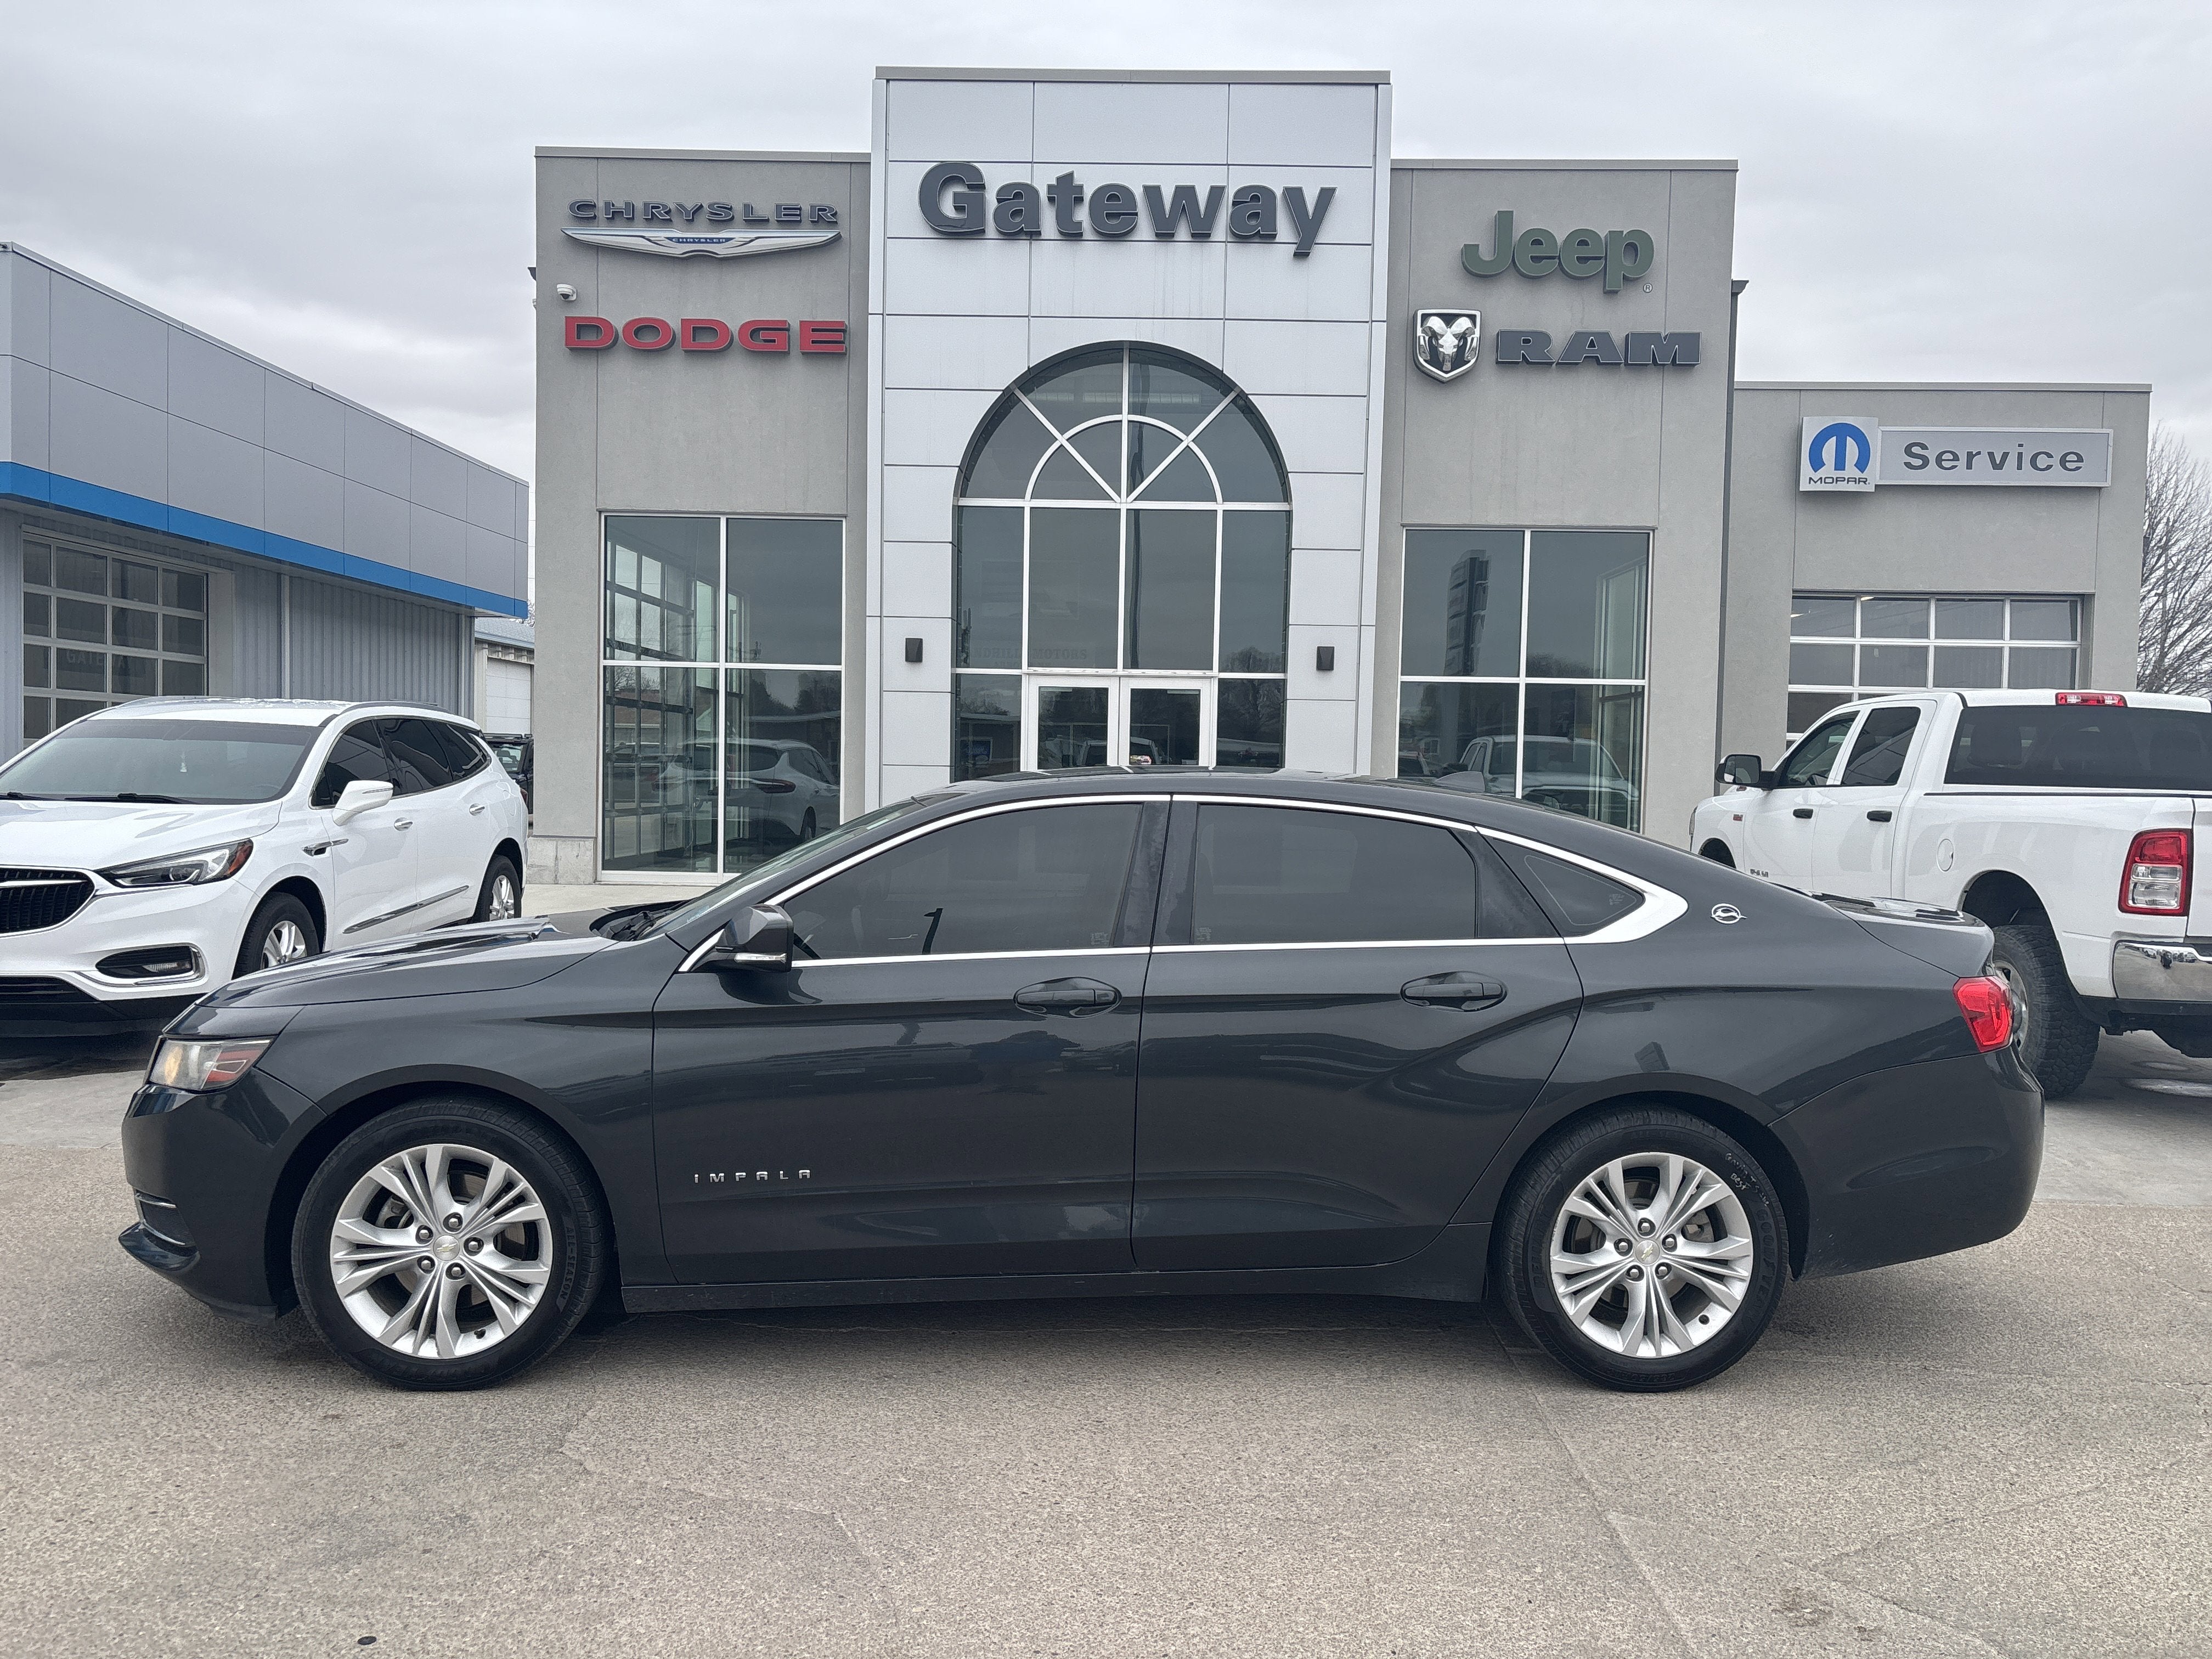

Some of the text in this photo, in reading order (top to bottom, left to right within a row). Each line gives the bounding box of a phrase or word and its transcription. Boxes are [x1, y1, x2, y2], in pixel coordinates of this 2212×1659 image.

[568, 199, 838, 223] CHRYSLER
[918, 161, 1338, 256] Gateway
[1461, 210, 1654, 293] Jeep
[565, 315, 847, 354] DODGE
[1496, 329, 1702, 366] RAM
[1903, 442, 2085, 472] Service
[1808, 476, 1868, 485] MOPAR
[695, 1170, 810, 1183] IMPALA
[560, 1227, 576, 1300] ALL-SEASON
